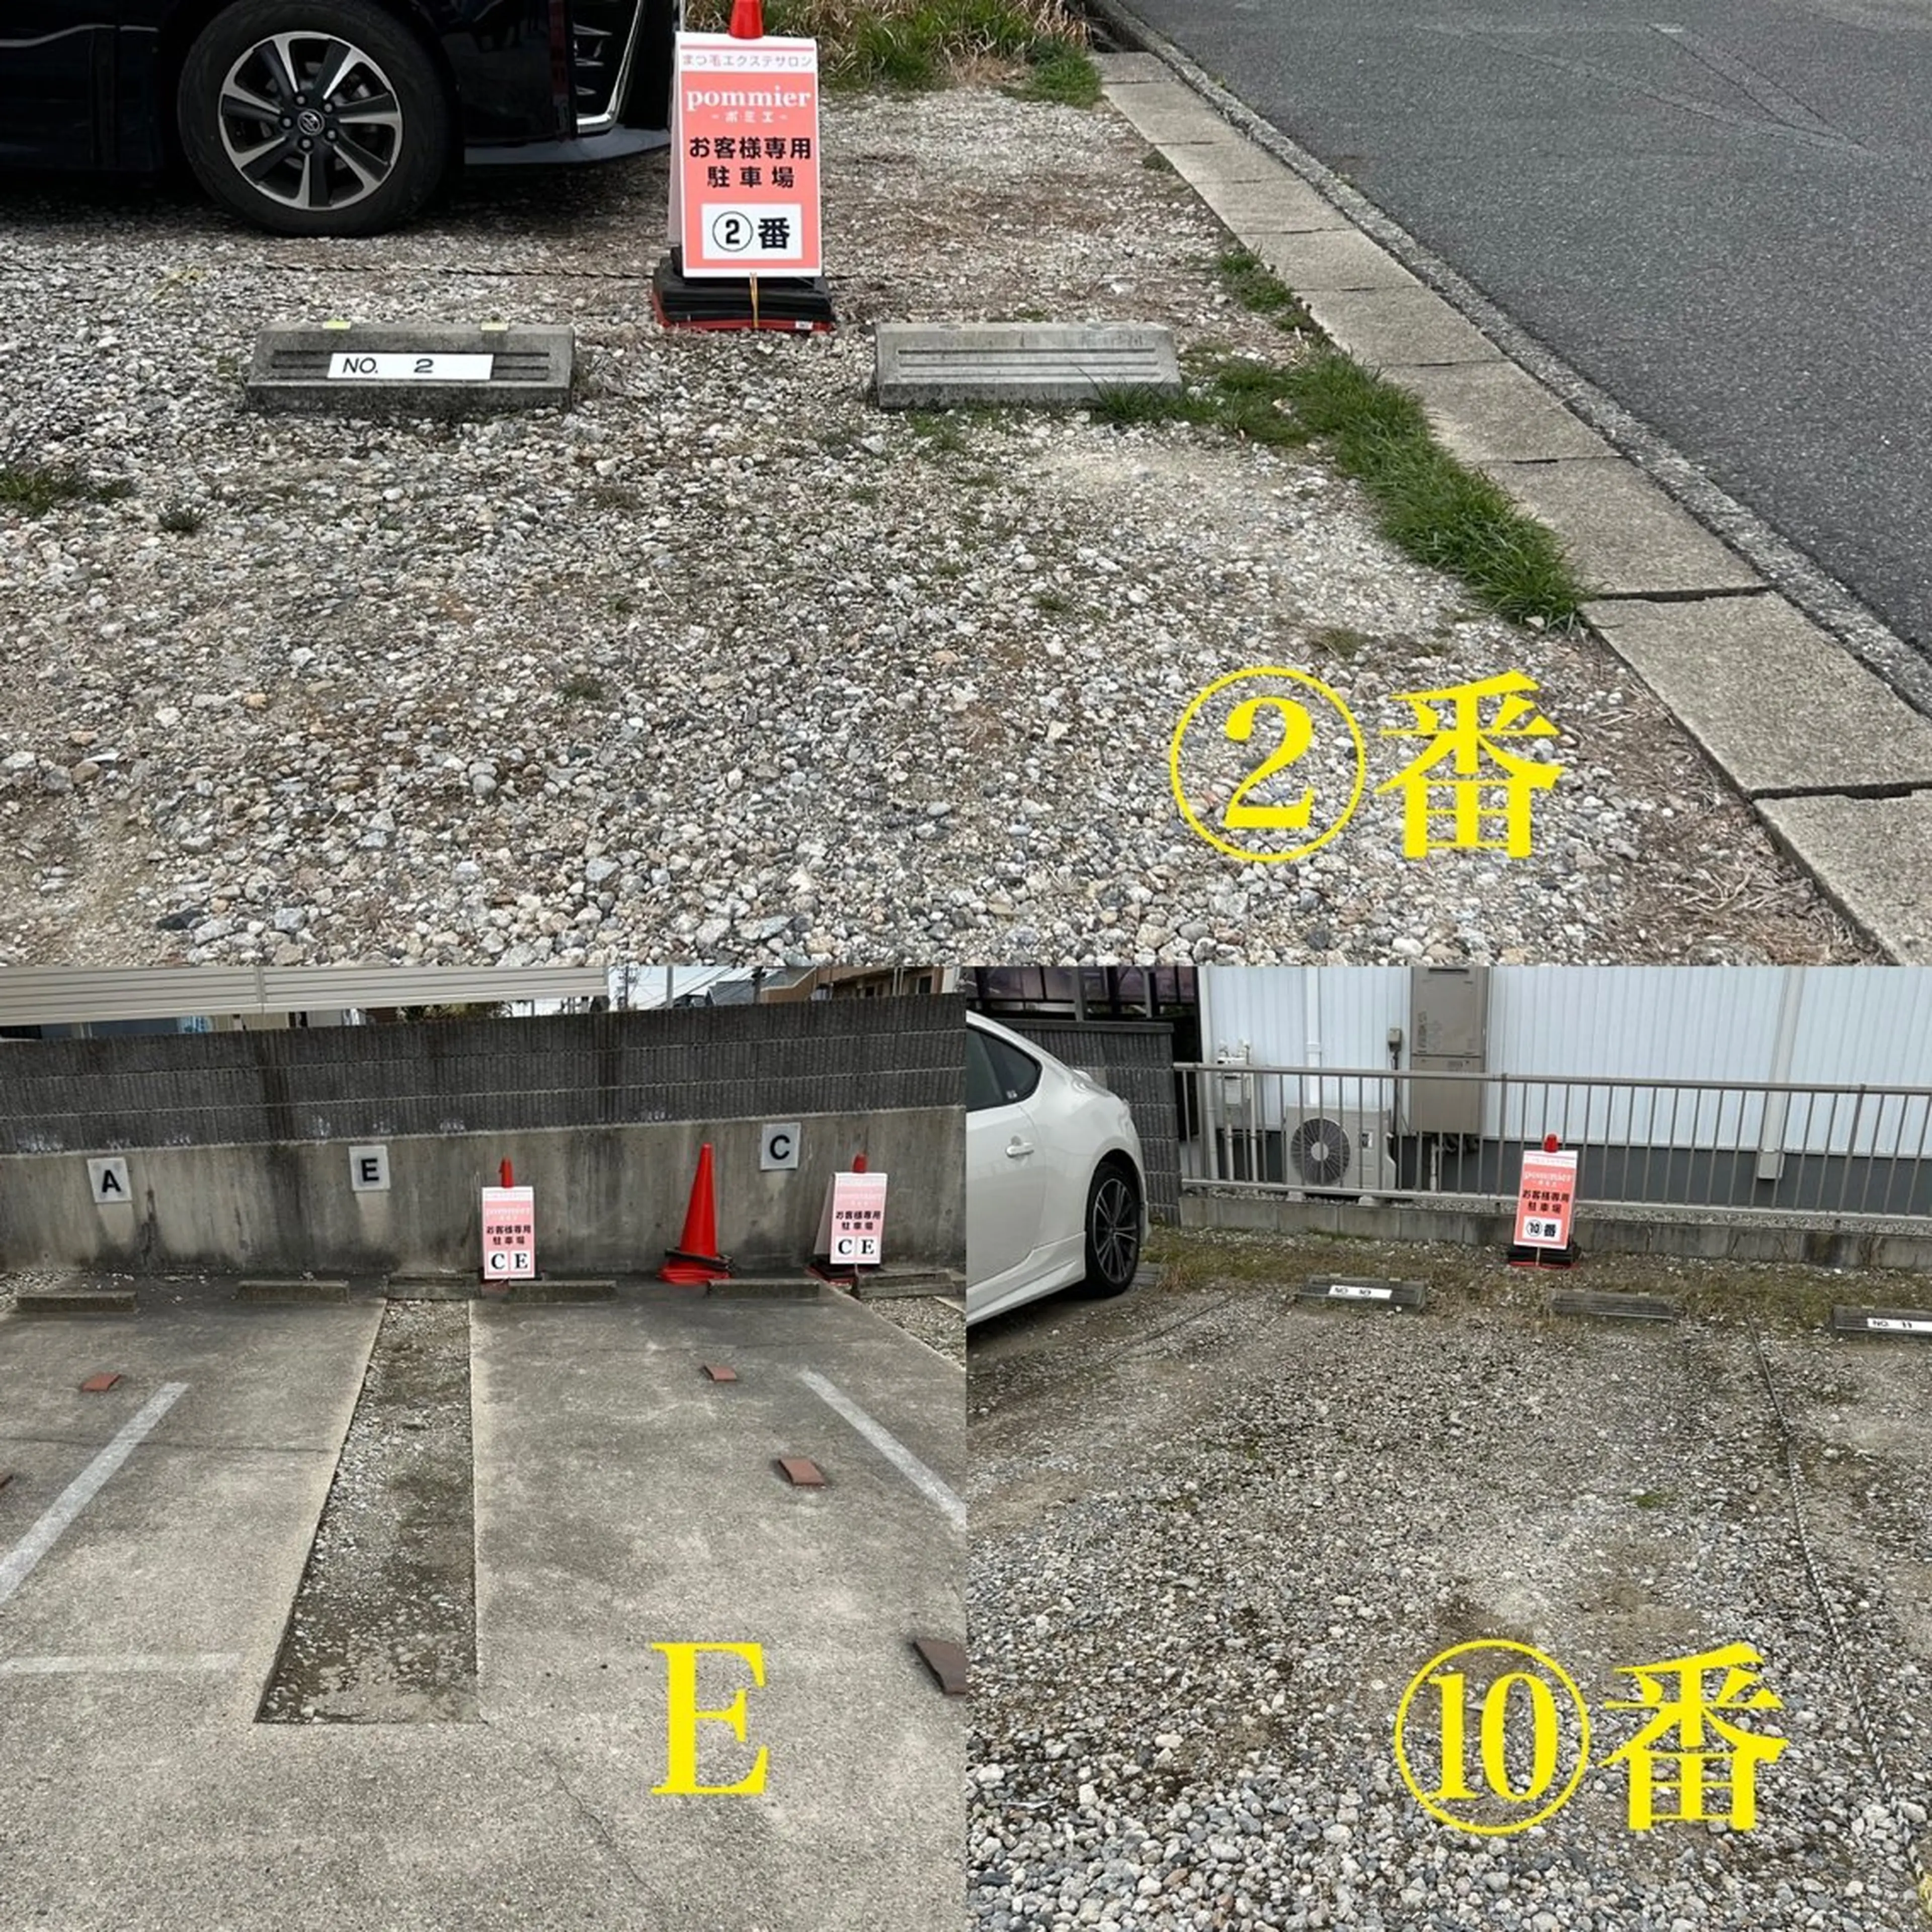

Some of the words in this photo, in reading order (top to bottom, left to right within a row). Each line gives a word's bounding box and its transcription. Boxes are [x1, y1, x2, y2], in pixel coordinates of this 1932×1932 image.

[683, 54, 812, 67] まつ毛エクステサロン
[687, 85, 811, 112] pommier
[689, 137, 811, 159] お客様専用
[707, 167, 794, 188] 駐車場
[343, 358, 378, 374] NO.
[414, 359, 434, 373] 2
[769, 1134, 790, 1160] C
[361, 1158, 379, 1181] E
[102, 1169, 121, 1192] A
[838, 1239, 852, 1254] C
[861, 1239, 874, 1254] E
[491, 1253, 505, 1269] C
[515, 1253, 528, 1269] E
